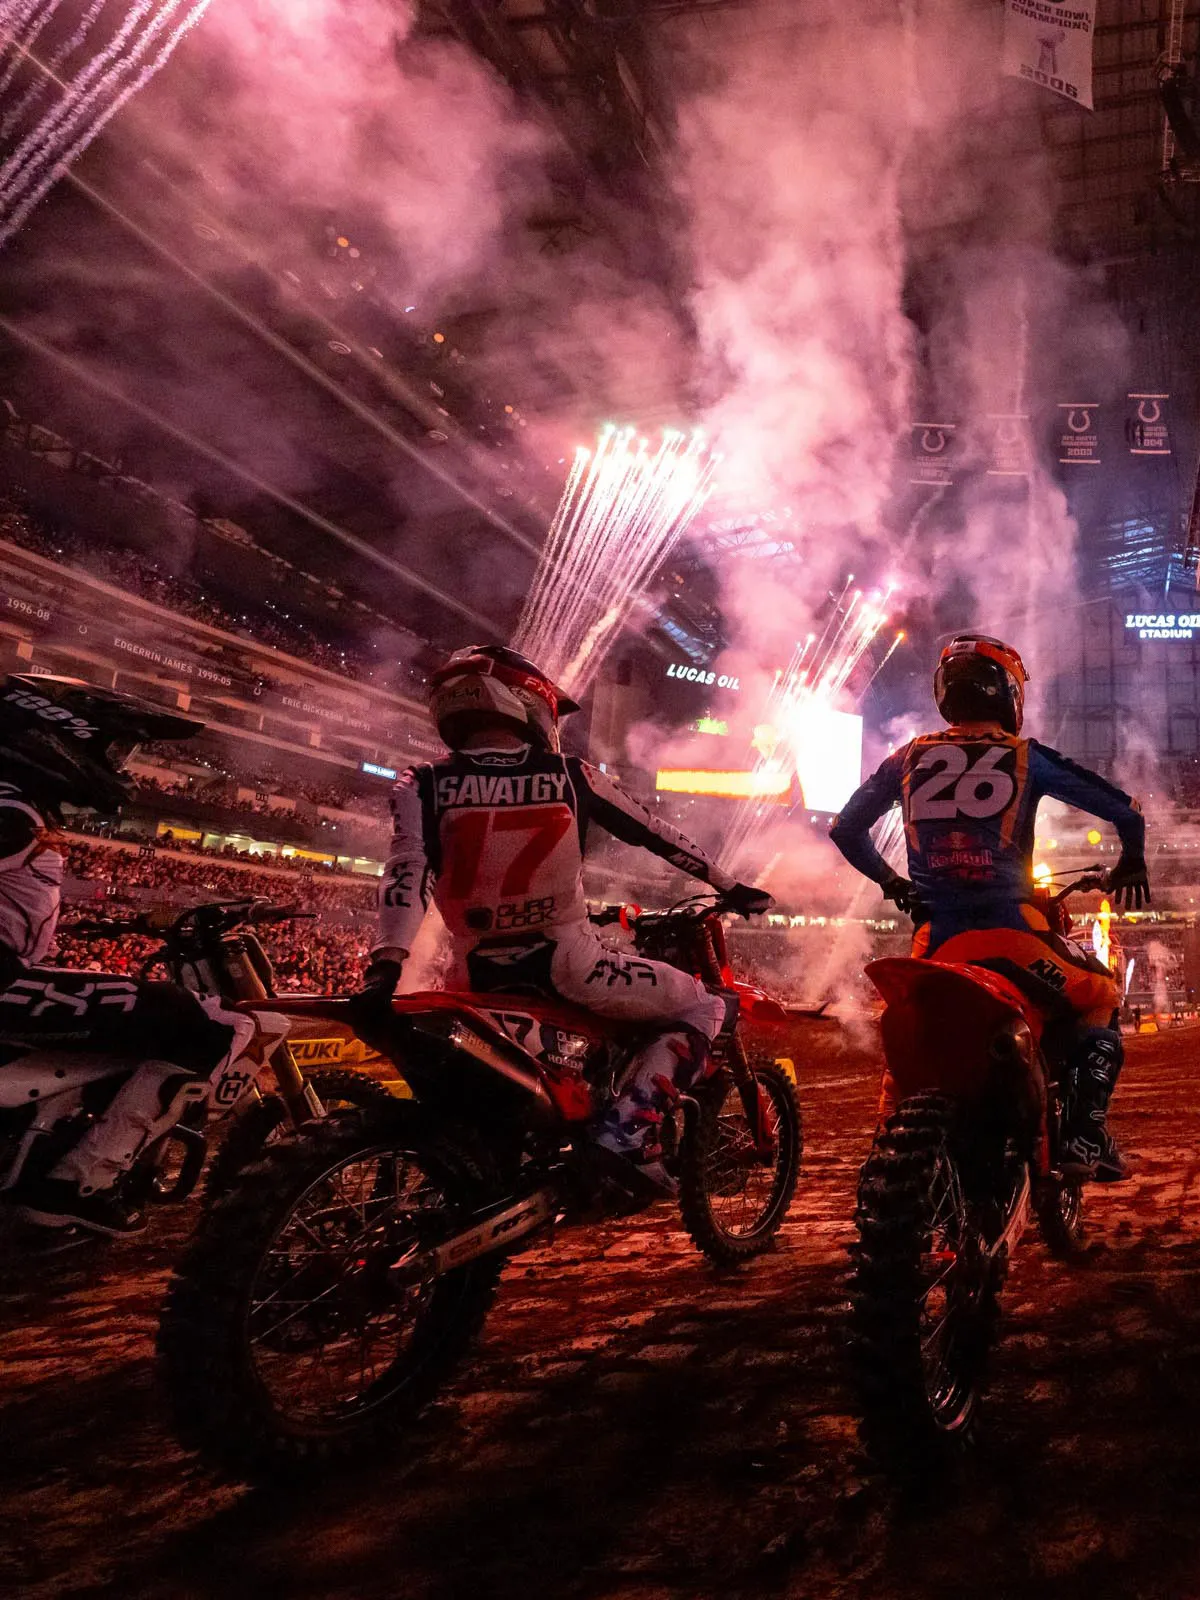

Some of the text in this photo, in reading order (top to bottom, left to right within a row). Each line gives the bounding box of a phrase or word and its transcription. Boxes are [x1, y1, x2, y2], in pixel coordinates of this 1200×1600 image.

[1011, 0, 1091, 23] UPER BOWL
[1011, 2, 1089, 33] CHAMPIONS
[1019, 63, 1078, 98] 2006
[7, 598, 51, 621] 1996-08
[1125, 615, 1175, 627] LUCAS
[1139, 629, 1193, 638] STADIUM
[113, 638, 233, 687] EDGERRIN JAMES 1999-05
[666, 663, 741, 690] LUCAS OIL
[3, 689, 101, 740] 100%
[282, 696, 301, 710] ERIC
[437, 773, 568, 806] SAVATGY
[909, 744, 1015, 821] 26
[446, 806, 572, 900] 17
[495, 911, 556, 931] LOCK
[497, 897, 554, 918] QUAD
[584, 959, 658, 986] FXR
[1028, 957, 1068, 991] KTM
[291, 1042, 342, 1060] ZUKI
[1087, 1051, 1112, 1072] FOX
